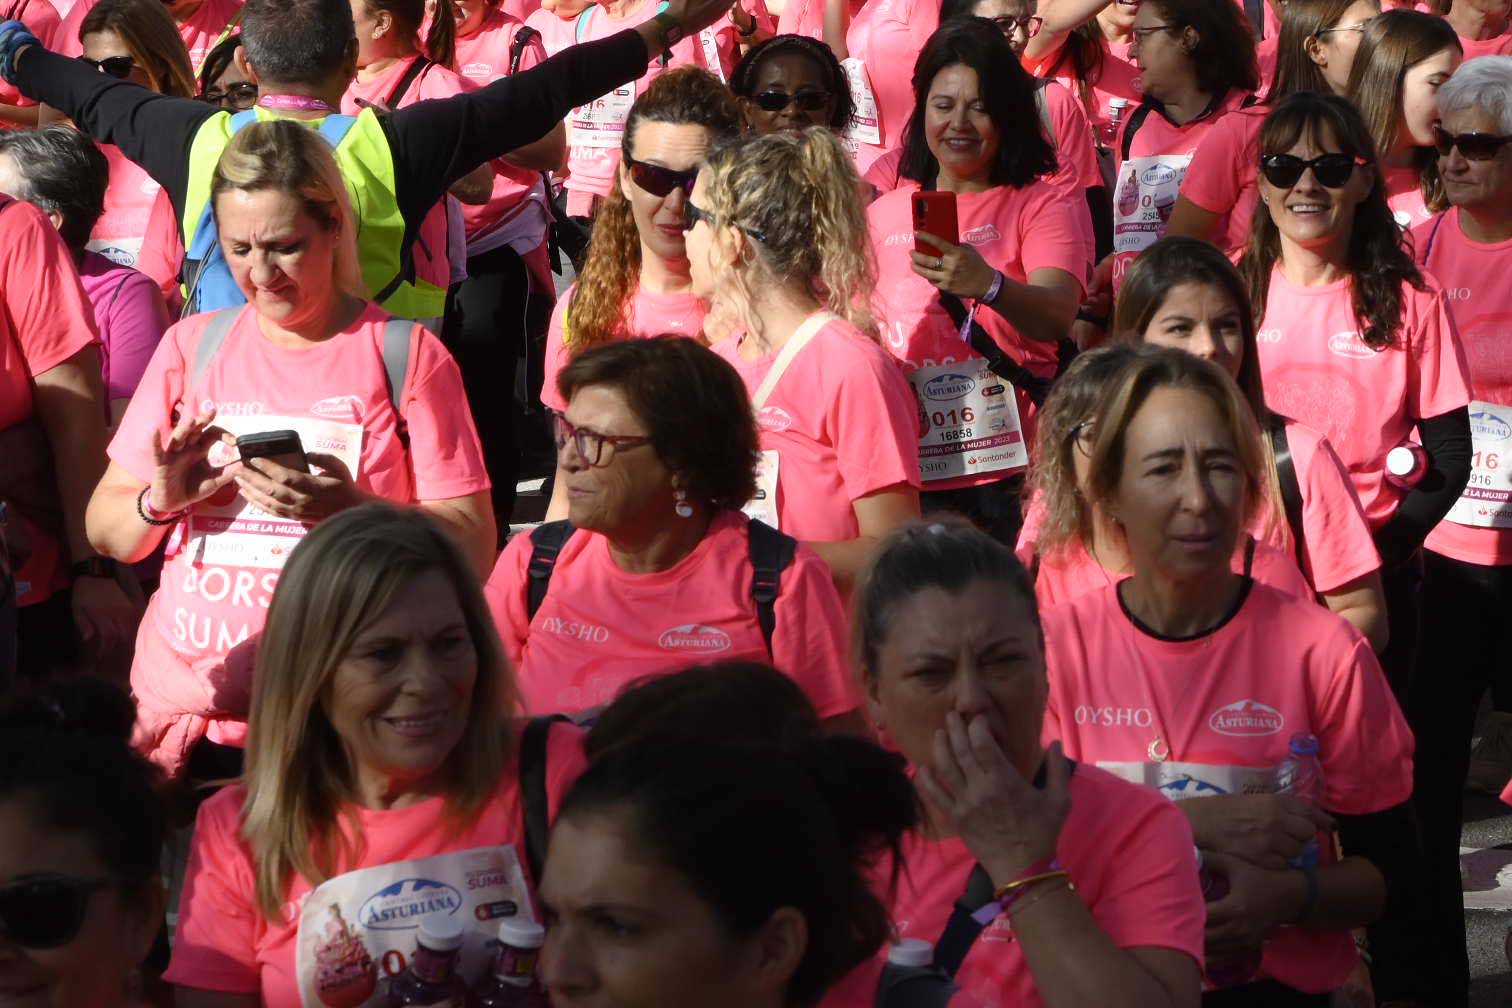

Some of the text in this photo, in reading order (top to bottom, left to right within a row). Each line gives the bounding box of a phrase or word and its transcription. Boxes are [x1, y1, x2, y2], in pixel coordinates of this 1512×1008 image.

[926, 383, 973, 398] ASTURIANA
[932, 407, 976, 428] 016
[939, 428, 973, 442] 16858
[966, 439, 992, 450] MUJER
[977, 449, 1017, 465] Santander
[1481, 490, 1509, 500] MUJER
[664, 634, 726, 649] ASTURIANA
[1074, 704, 1153, 728] OYSHO
[1214, 714, 1279, 730] ASTURIANA
[468, 875, 509, 890] SUMA
[367, 896, 456, 924] ASTURIANA
